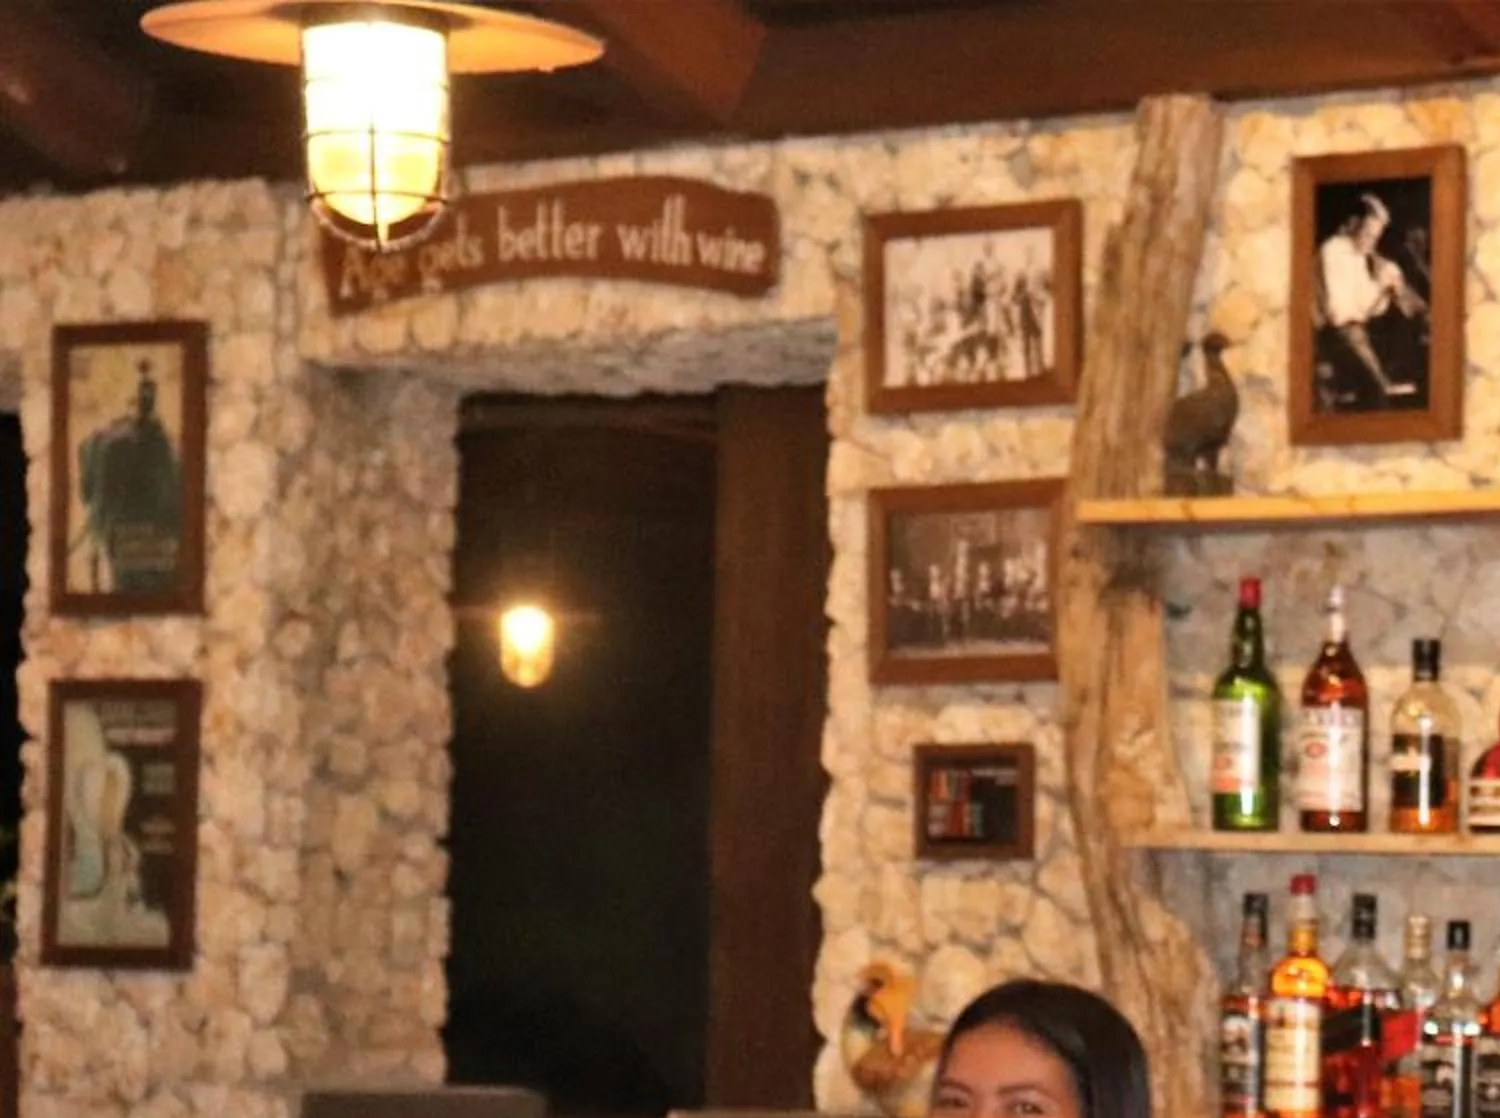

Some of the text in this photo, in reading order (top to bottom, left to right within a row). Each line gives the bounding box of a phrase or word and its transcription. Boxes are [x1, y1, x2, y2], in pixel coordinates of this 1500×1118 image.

[497, 198, 601, 264] better
[615, 193, 693, 267] with
[696, 225, 767, 275] wine
